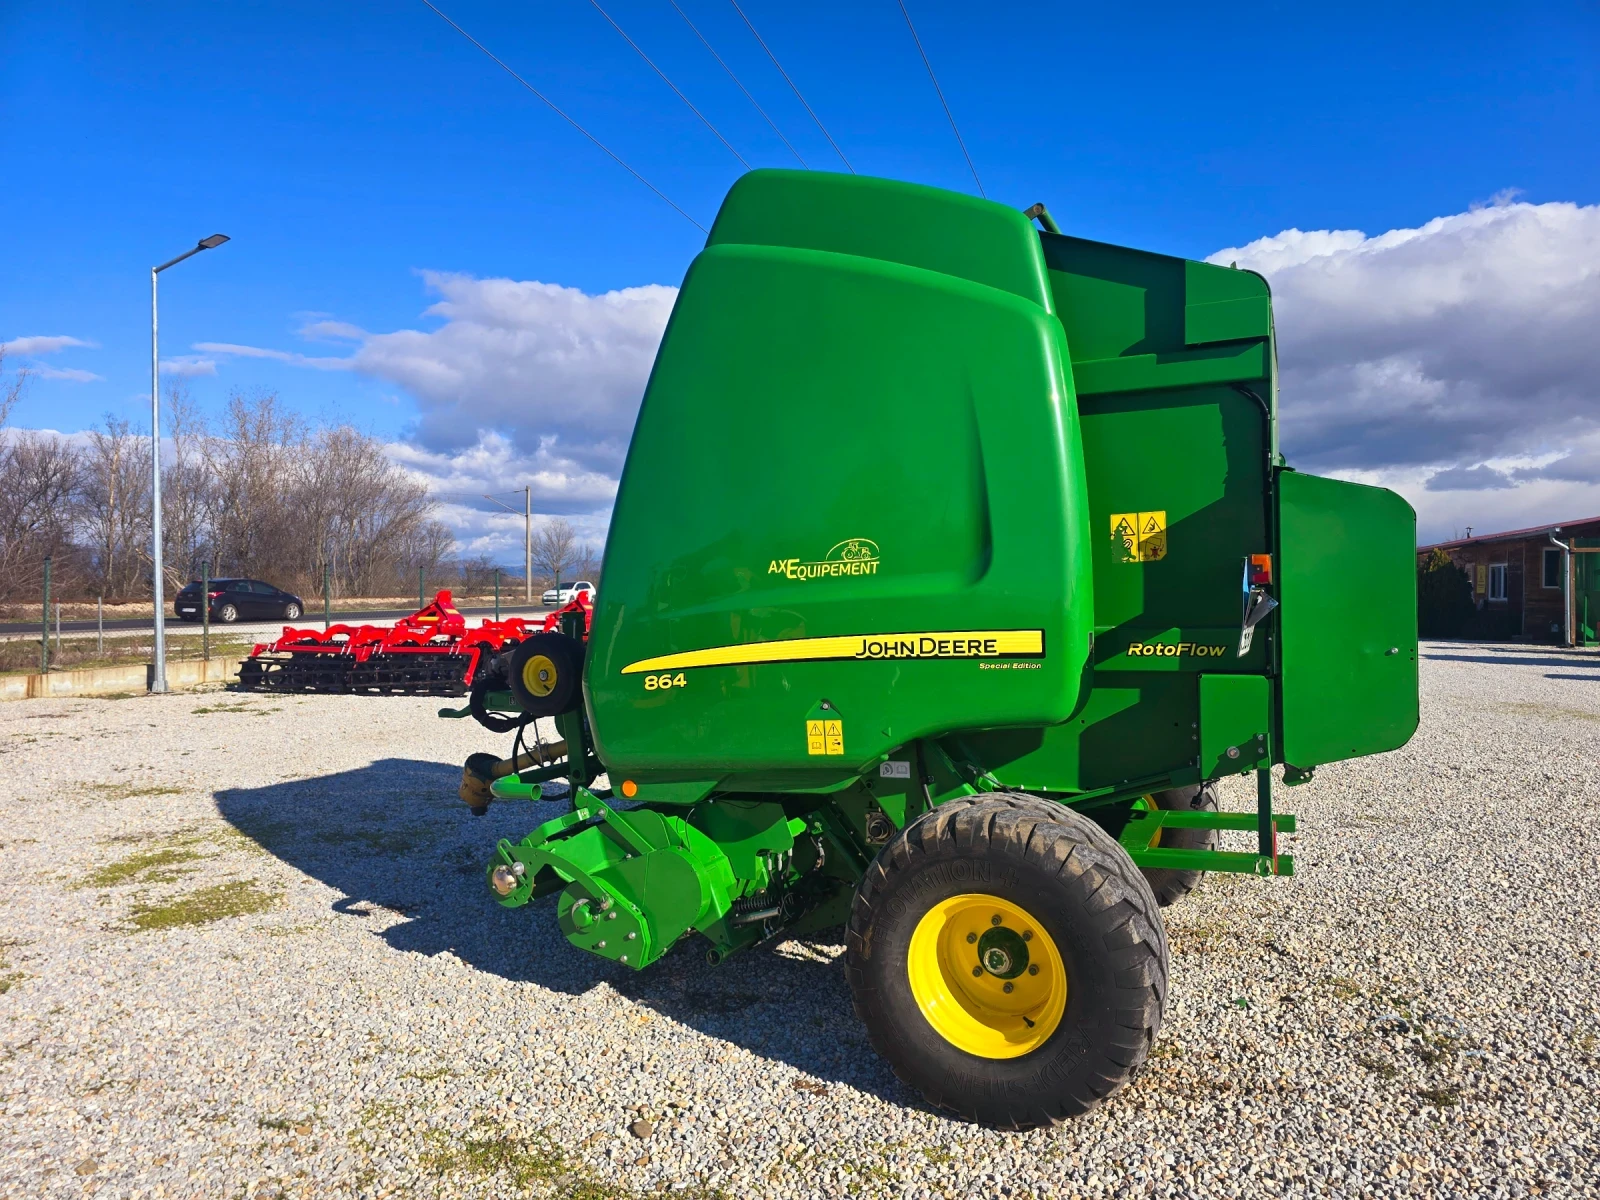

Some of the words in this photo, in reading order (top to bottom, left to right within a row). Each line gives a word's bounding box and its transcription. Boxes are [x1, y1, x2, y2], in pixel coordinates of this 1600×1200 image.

[855, 639, 915, 657] JOHN
[919, 637, 998, 655] DEERE
[1127, 642, 1227, 657] RotoFlow
[979, 662, 1011, 670] Special
[1012, 661, 1042, 669] Edition
[644, 672, 688, 691] 864
[873, 859, 992, 948] FLOTATION
